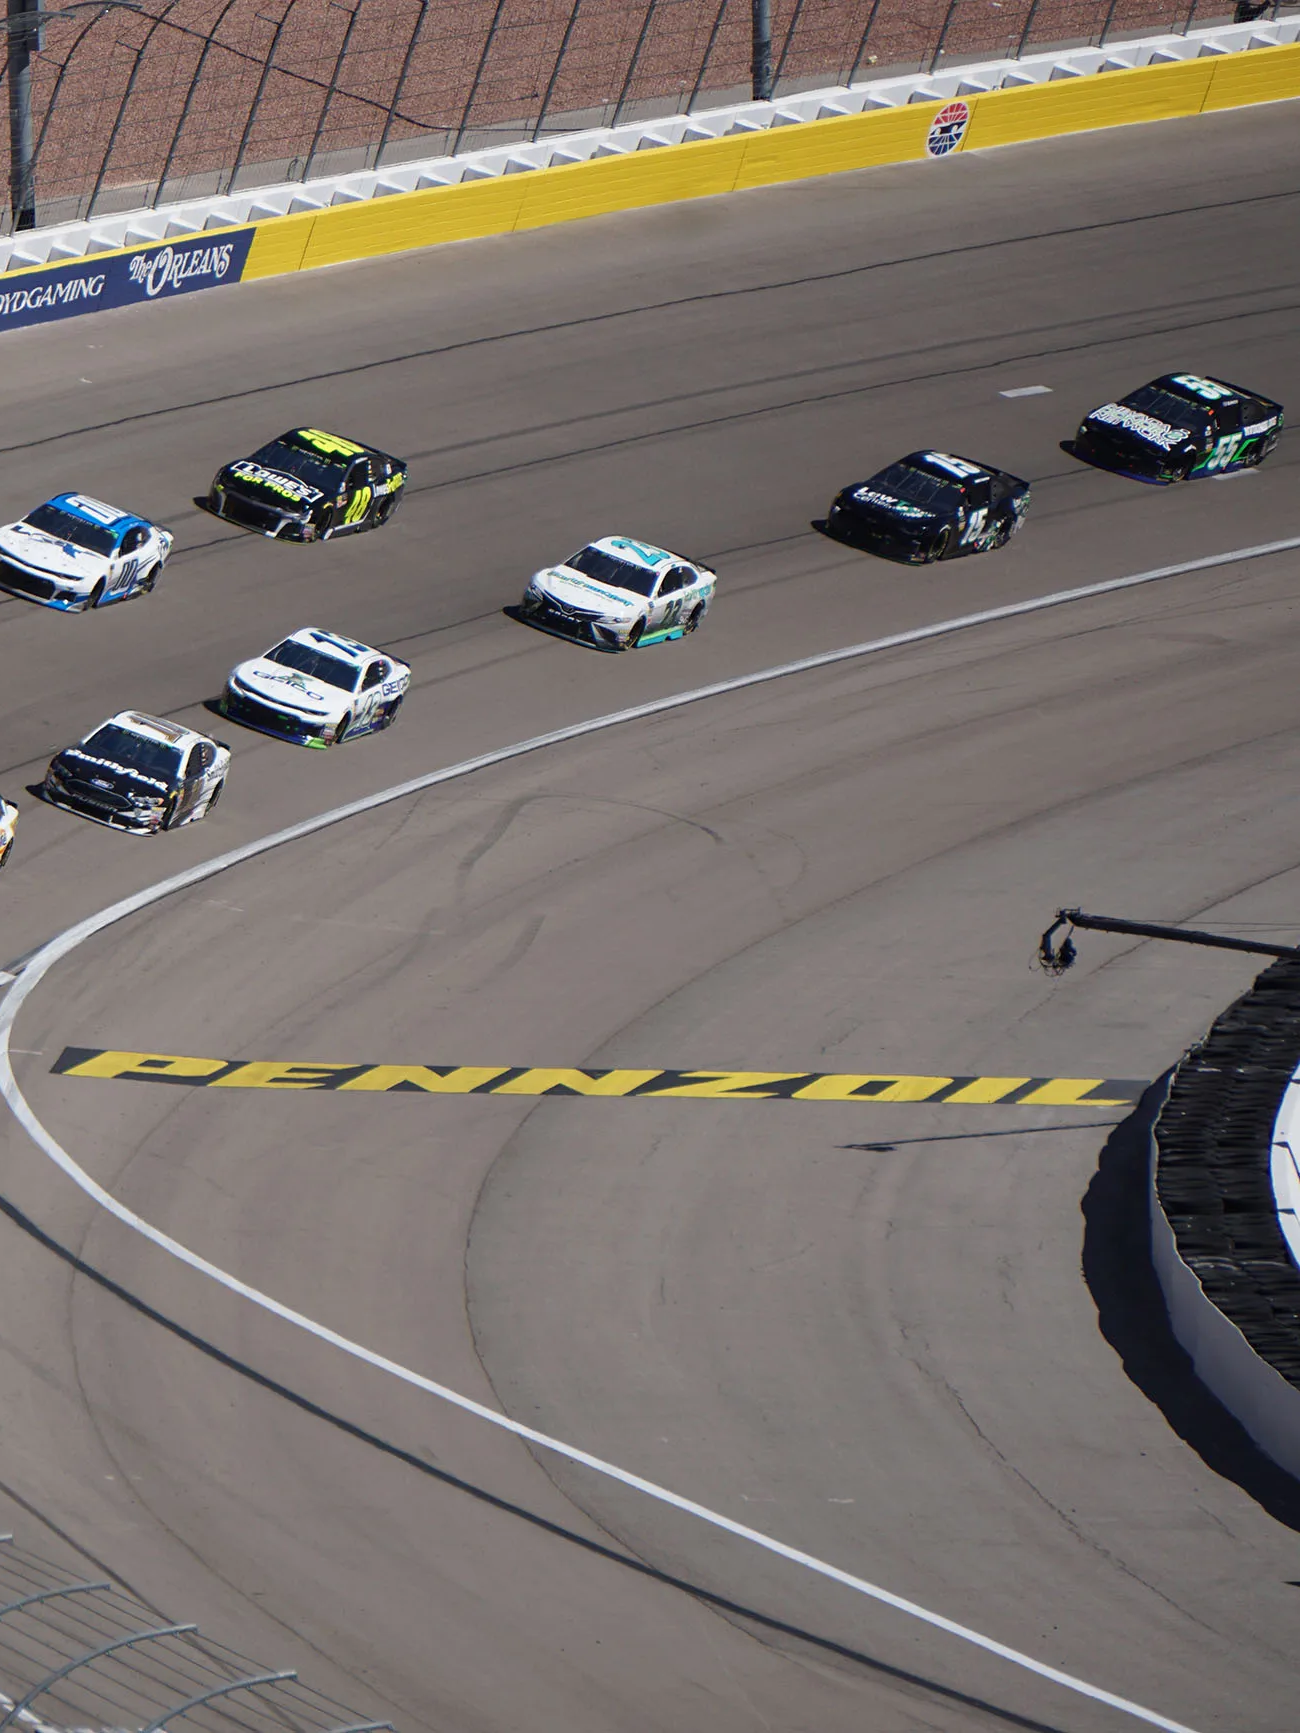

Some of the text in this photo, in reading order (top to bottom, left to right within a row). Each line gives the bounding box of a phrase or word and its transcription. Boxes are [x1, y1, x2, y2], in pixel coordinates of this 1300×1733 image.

[129, 245, 234, 296] The ORLEANS
[1207, 434, 1243, 470] 55
[961, 508, 988, 546] 15
[253, 670, 325, 700] GEICO
[60, 1051, 1134, 1107] PENNZOIL
